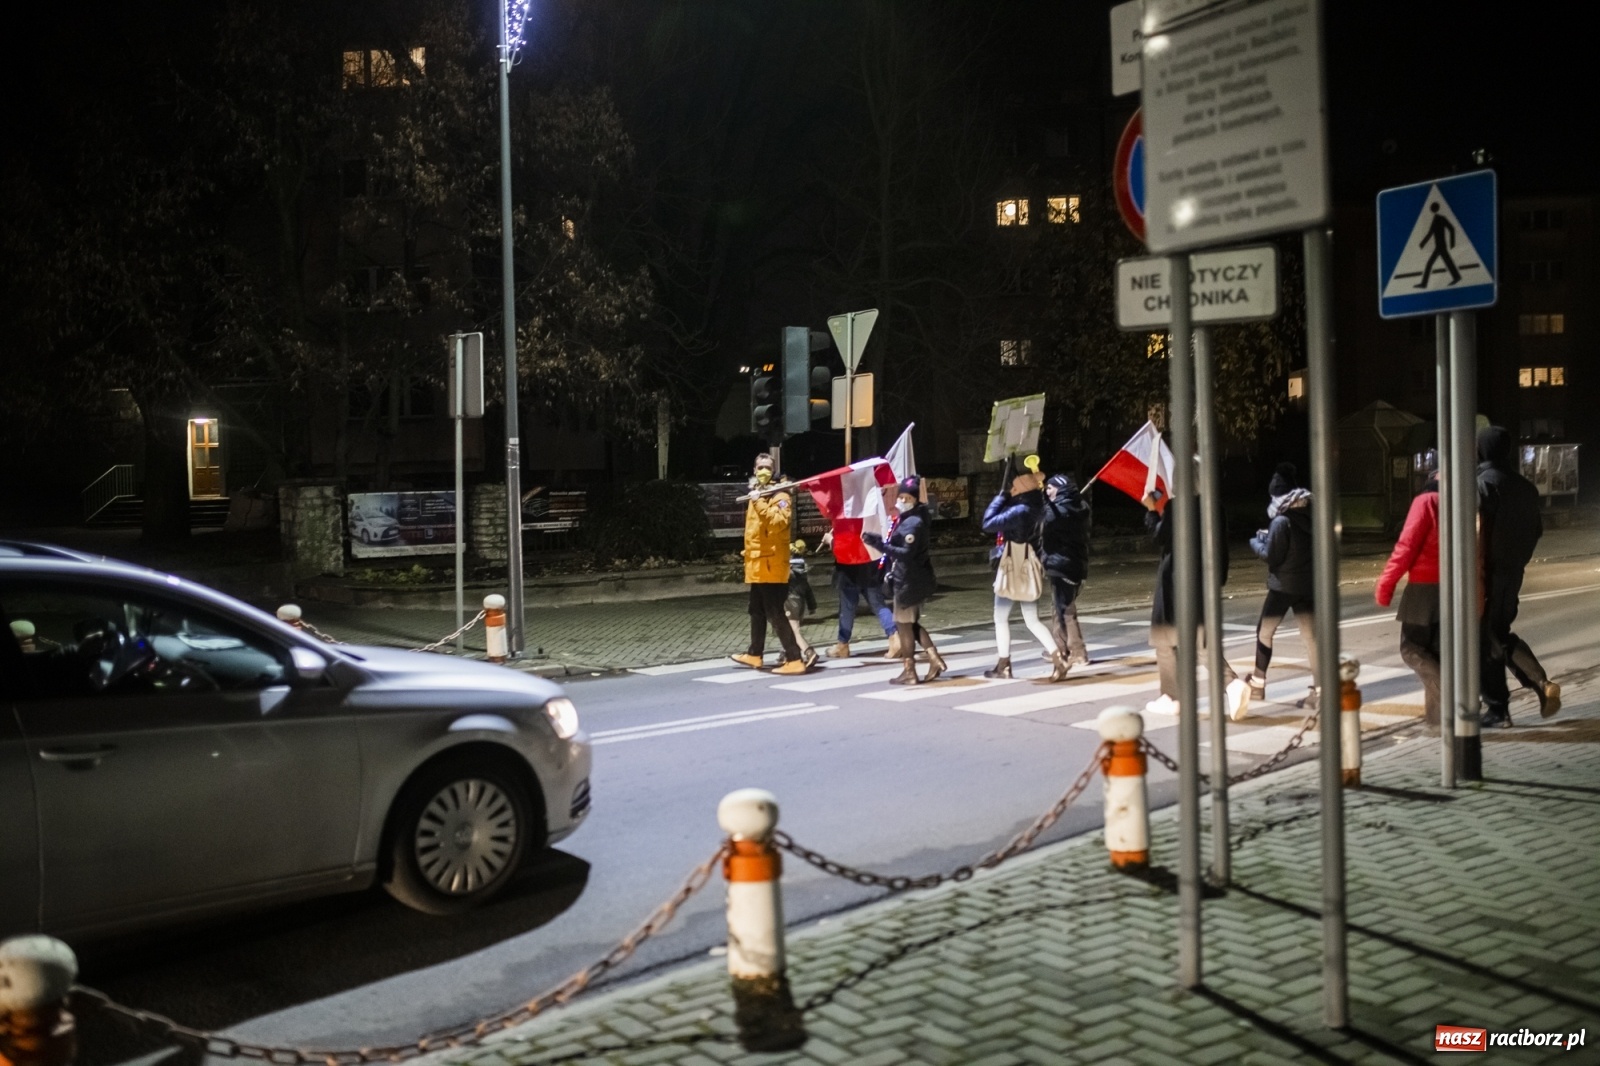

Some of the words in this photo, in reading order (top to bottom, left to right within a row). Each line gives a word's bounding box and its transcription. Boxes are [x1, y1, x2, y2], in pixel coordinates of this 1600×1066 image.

[1131, 272, 1161, 290] NIE
[1186, 263, 1262, 285] TYCZY
[1144, 288, 1249, 312] CHDNIKA
